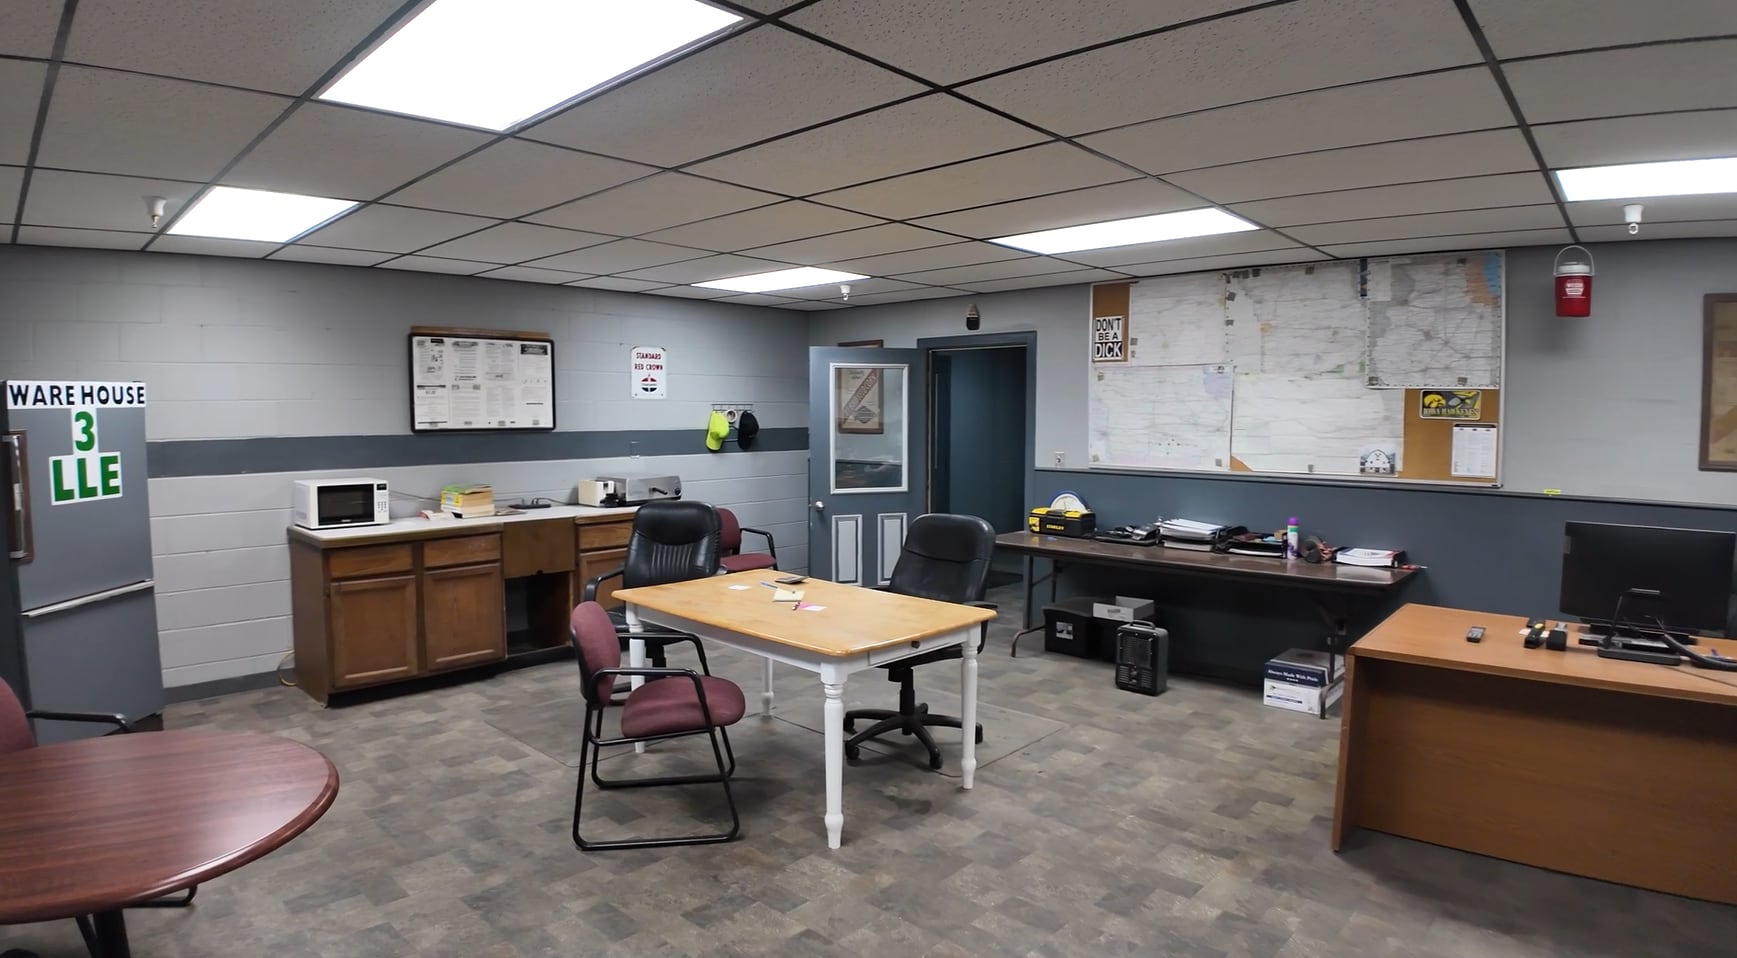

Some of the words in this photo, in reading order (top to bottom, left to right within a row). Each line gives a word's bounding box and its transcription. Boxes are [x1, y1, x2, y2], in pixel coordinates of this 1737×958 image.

[1098, 332, 1110, 341] BE
[1112, 332, 1119, 341] A
[636, 352, 661, 360] STANDARD
[1095, 342, 1122, 358] DICK
[646, 363, 663, 371] CROWN
[75, 411, 95, 452] 3
[52, 455, 120, 502] LLE
